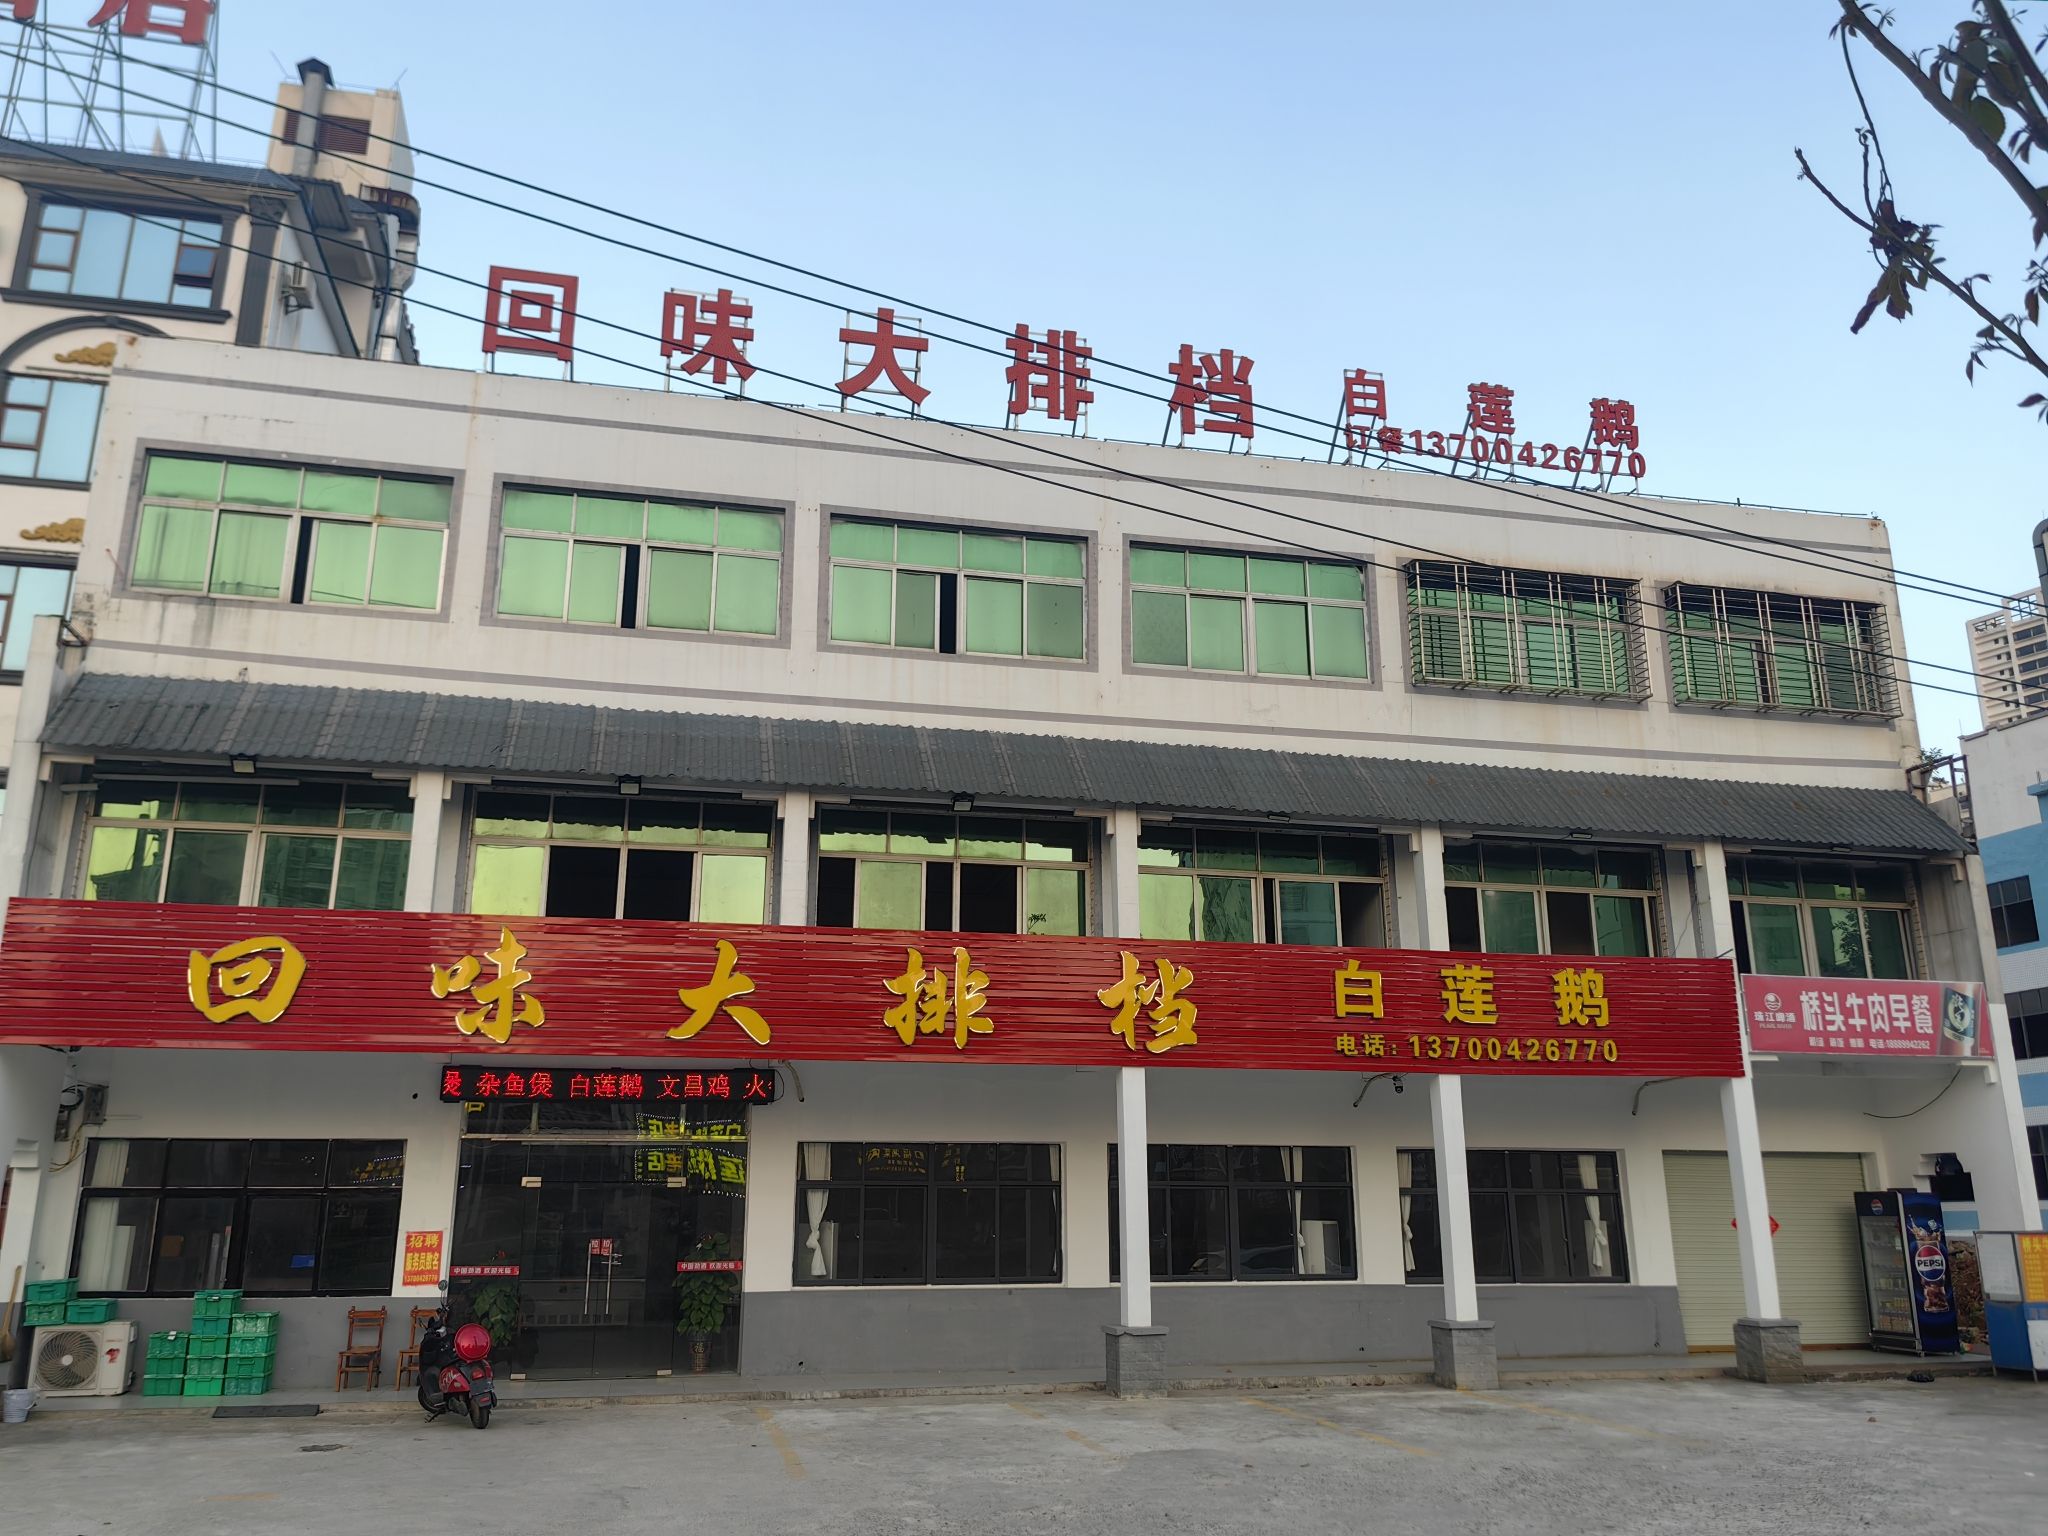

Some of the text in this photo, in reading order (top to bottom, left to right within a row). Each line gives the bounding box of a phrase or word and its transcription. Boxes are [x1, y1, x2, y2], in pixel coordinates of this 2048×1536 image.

[482, 265, 1639, 450] 回味大排档 白莲鹅
[187, 926, 1609, 1053] 回味大排档 白莲鹅
[570, 1073, 642, 1098] 白莲鹅
[656, 1074, 730, 1098] 文昌鸡
[409, 1233, 440, 1248] 招聘
[1917, 1258, 1943, 1268] PEPSI
